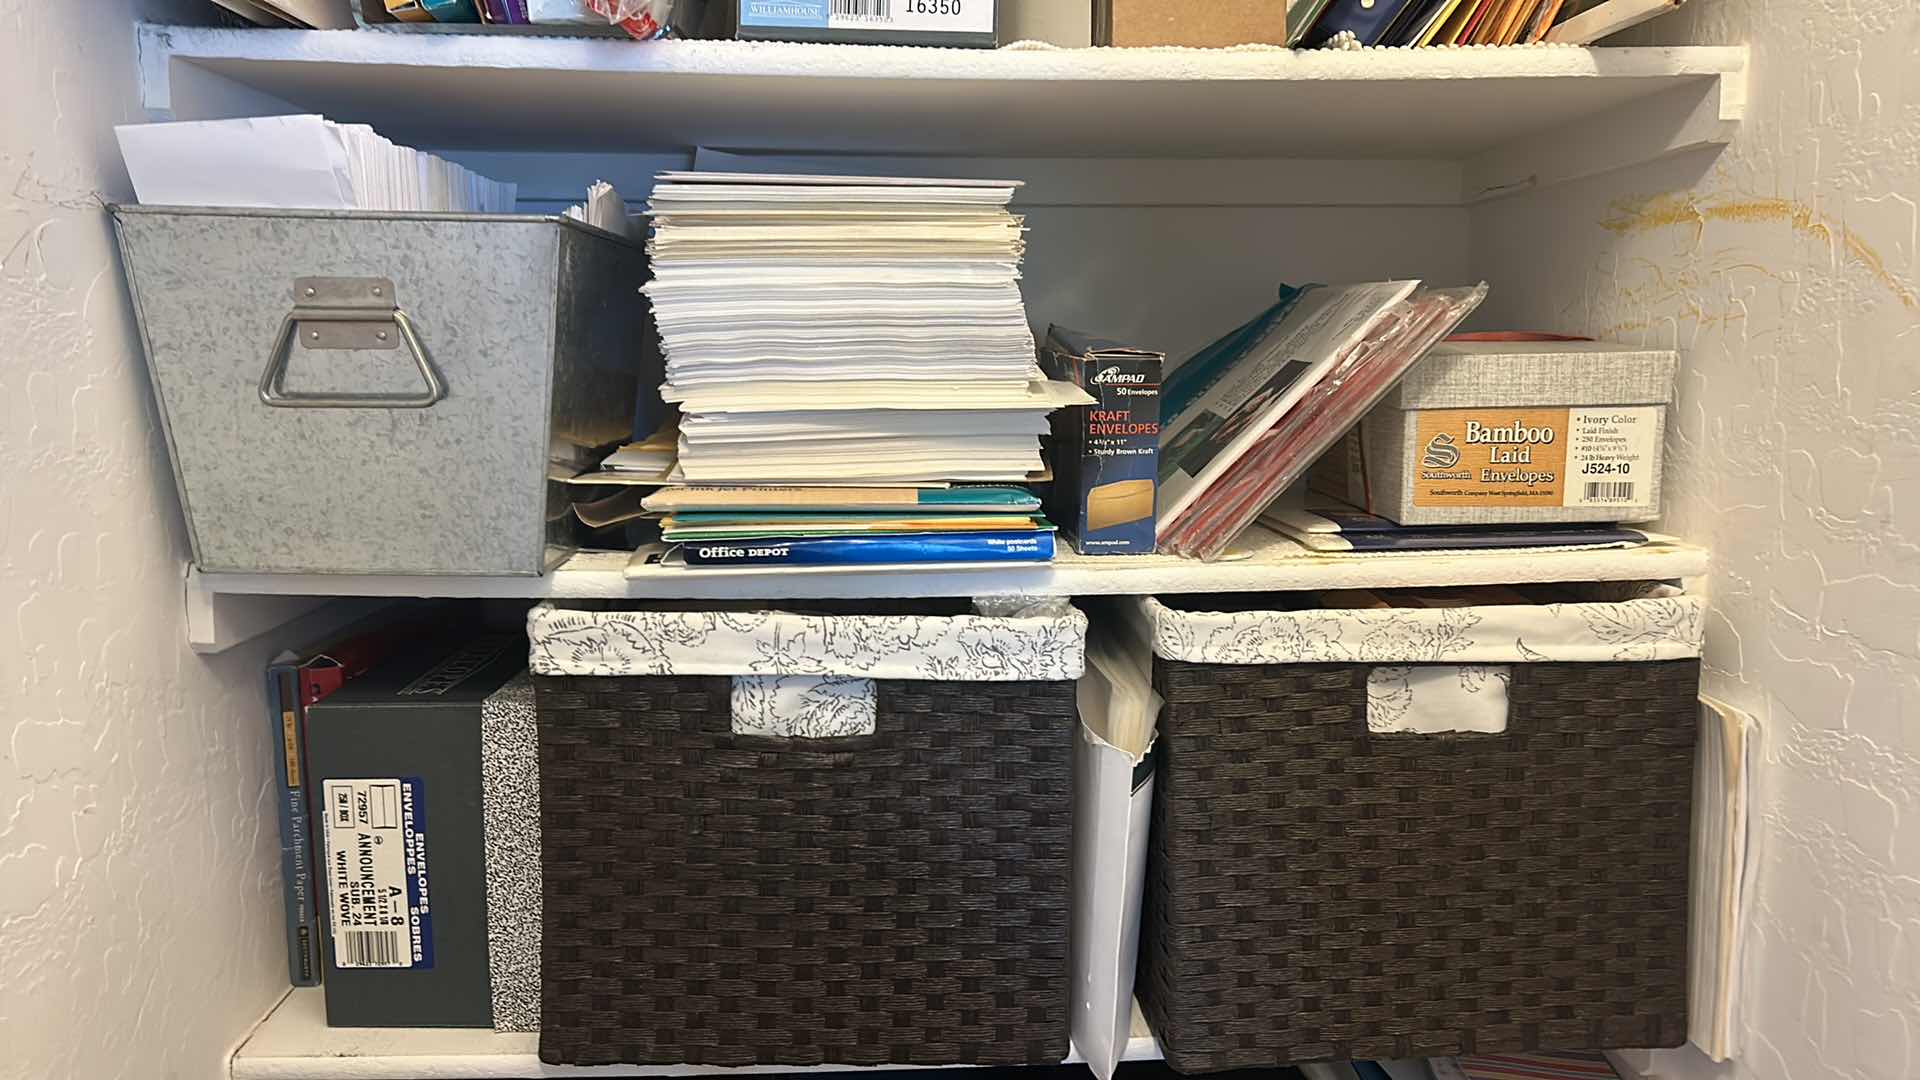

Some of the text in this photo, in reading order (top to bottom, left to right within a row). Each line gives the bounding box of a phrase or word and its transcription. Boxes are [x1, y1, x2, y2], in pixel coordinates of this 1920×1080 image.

[906, 0, 961, 15] 16350
[1102, 374, 1145, 384] AMPAD
[1116, 387, 1159, 397] 50 Envelopes
[1089, 410, 1131, 422] KRAFT
[1583, 415, 1637, 426] Ivory Color
[1089, 423, 1159, 435] ENVELOPES
[1465, 420, 1555, 444] Bamboo
[1594, 436, 1627, 444] Envelopes
[1093, 448, 1115, 456] Sturdy
[1489, 446, 1532, 465] Laid
[1595, 454, 1615, 462] Heavy
[1616, 454, 1640, 462] Weight
[1421, 470, 1472, 480] Southworth
[1479, 467, 1555, 486] Envelopes
[1581, 463, 1630, 475] J524-10
[699, 546, 789, 559] Office DEPOT
[289, 790, 301, 813] Fine
[357, 790, 368, 825] 72957
[402, 782, 417, 876] ENVELOPPES
[291, 816, 304, 870] Parchment
[357, 832, 377, 927] ANNOUNCEMENT
[414, 832, 430, 915] ENVELOPES
[294, 873, 307, 901] Paper
[336, 850, 351, 927] WHITE WOVE
[350, 880, 362, 926] SUB. 24
[410, 906, 423, 962] SOBRES
